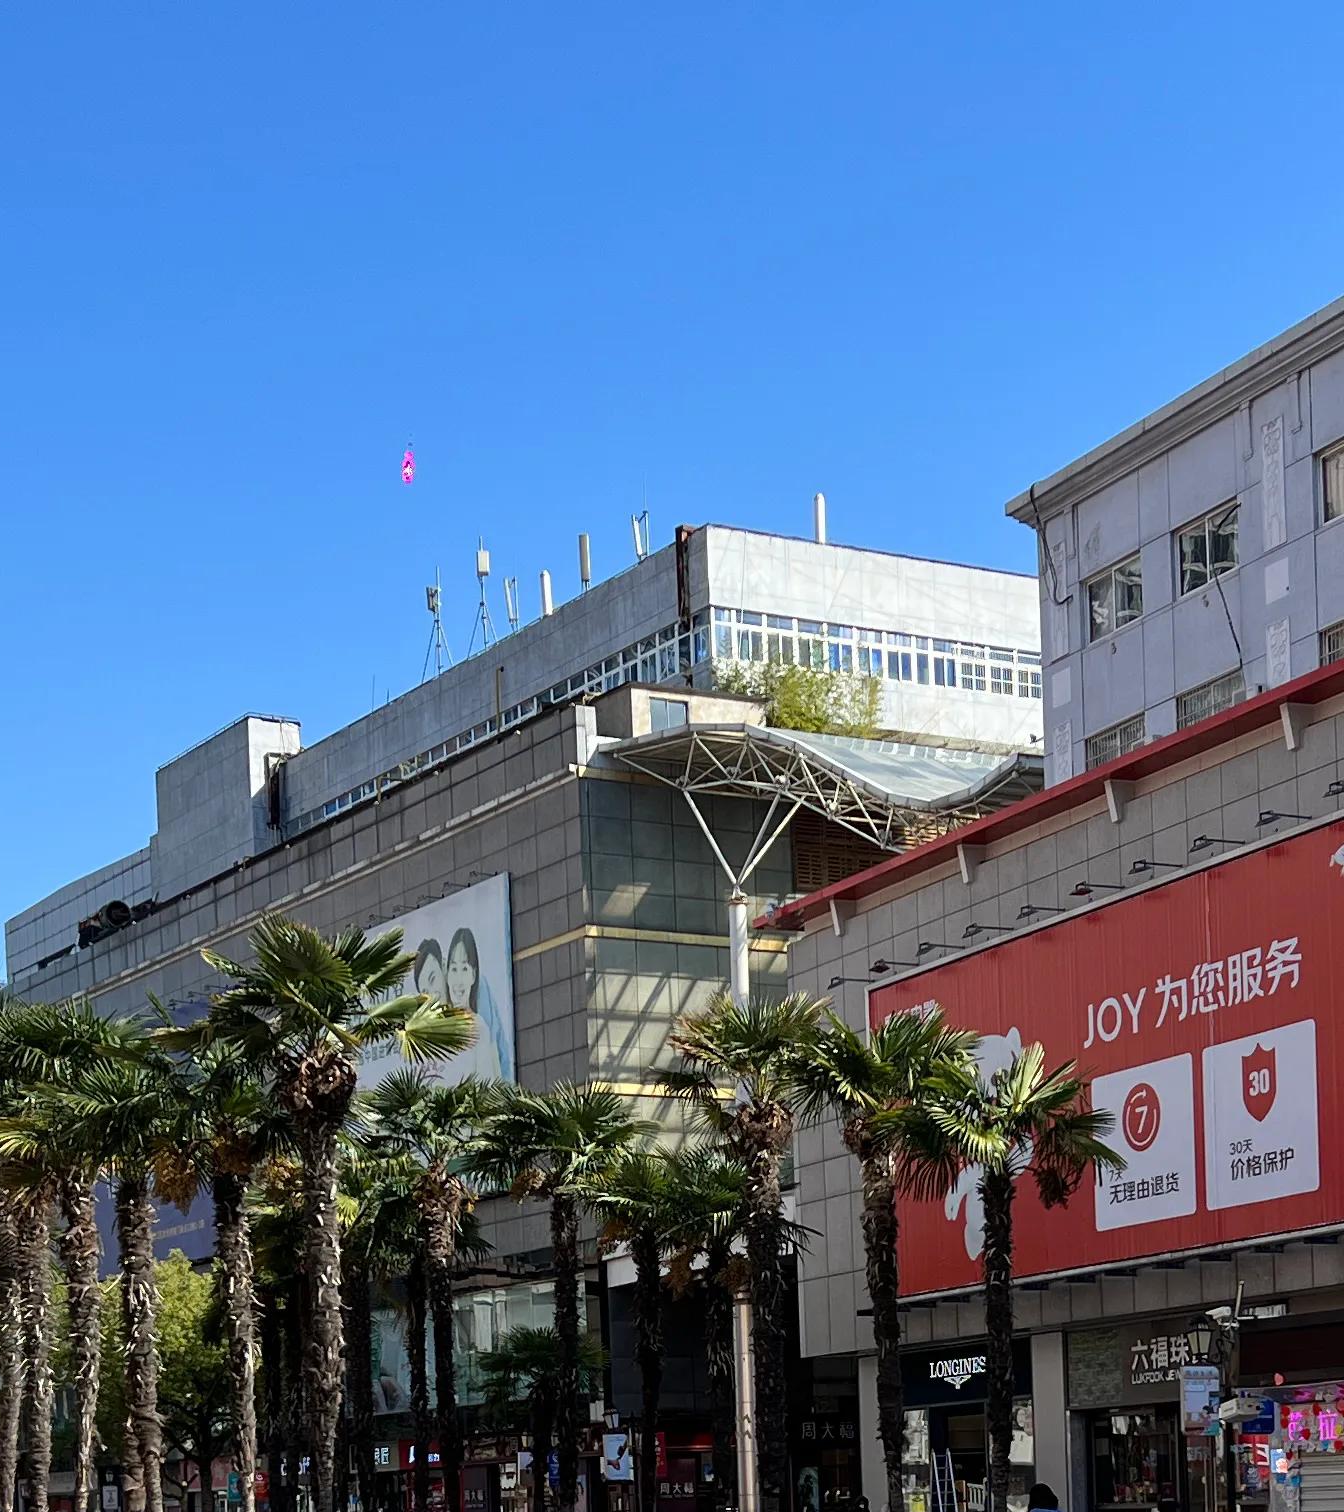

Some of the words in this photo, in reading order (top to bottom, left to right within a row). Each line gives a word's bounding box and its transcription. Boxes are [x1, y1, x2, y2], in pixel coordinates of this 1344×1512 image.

[1084, 987, 1146, 1049] JOY
[1155, 937, 1302, 1028] 为您服务
[1248, 1068, 1270, 1096] 30
[1229, 1138, 1253, 1155] 30天
[1230, 1148, 1295, 1181] 价格保护
[1109, 1172, 1180, 1205] 无理由退货
[929, 1355, 987, 1378] LONGINES
[659, 1481, 695, 1494] 周大福
